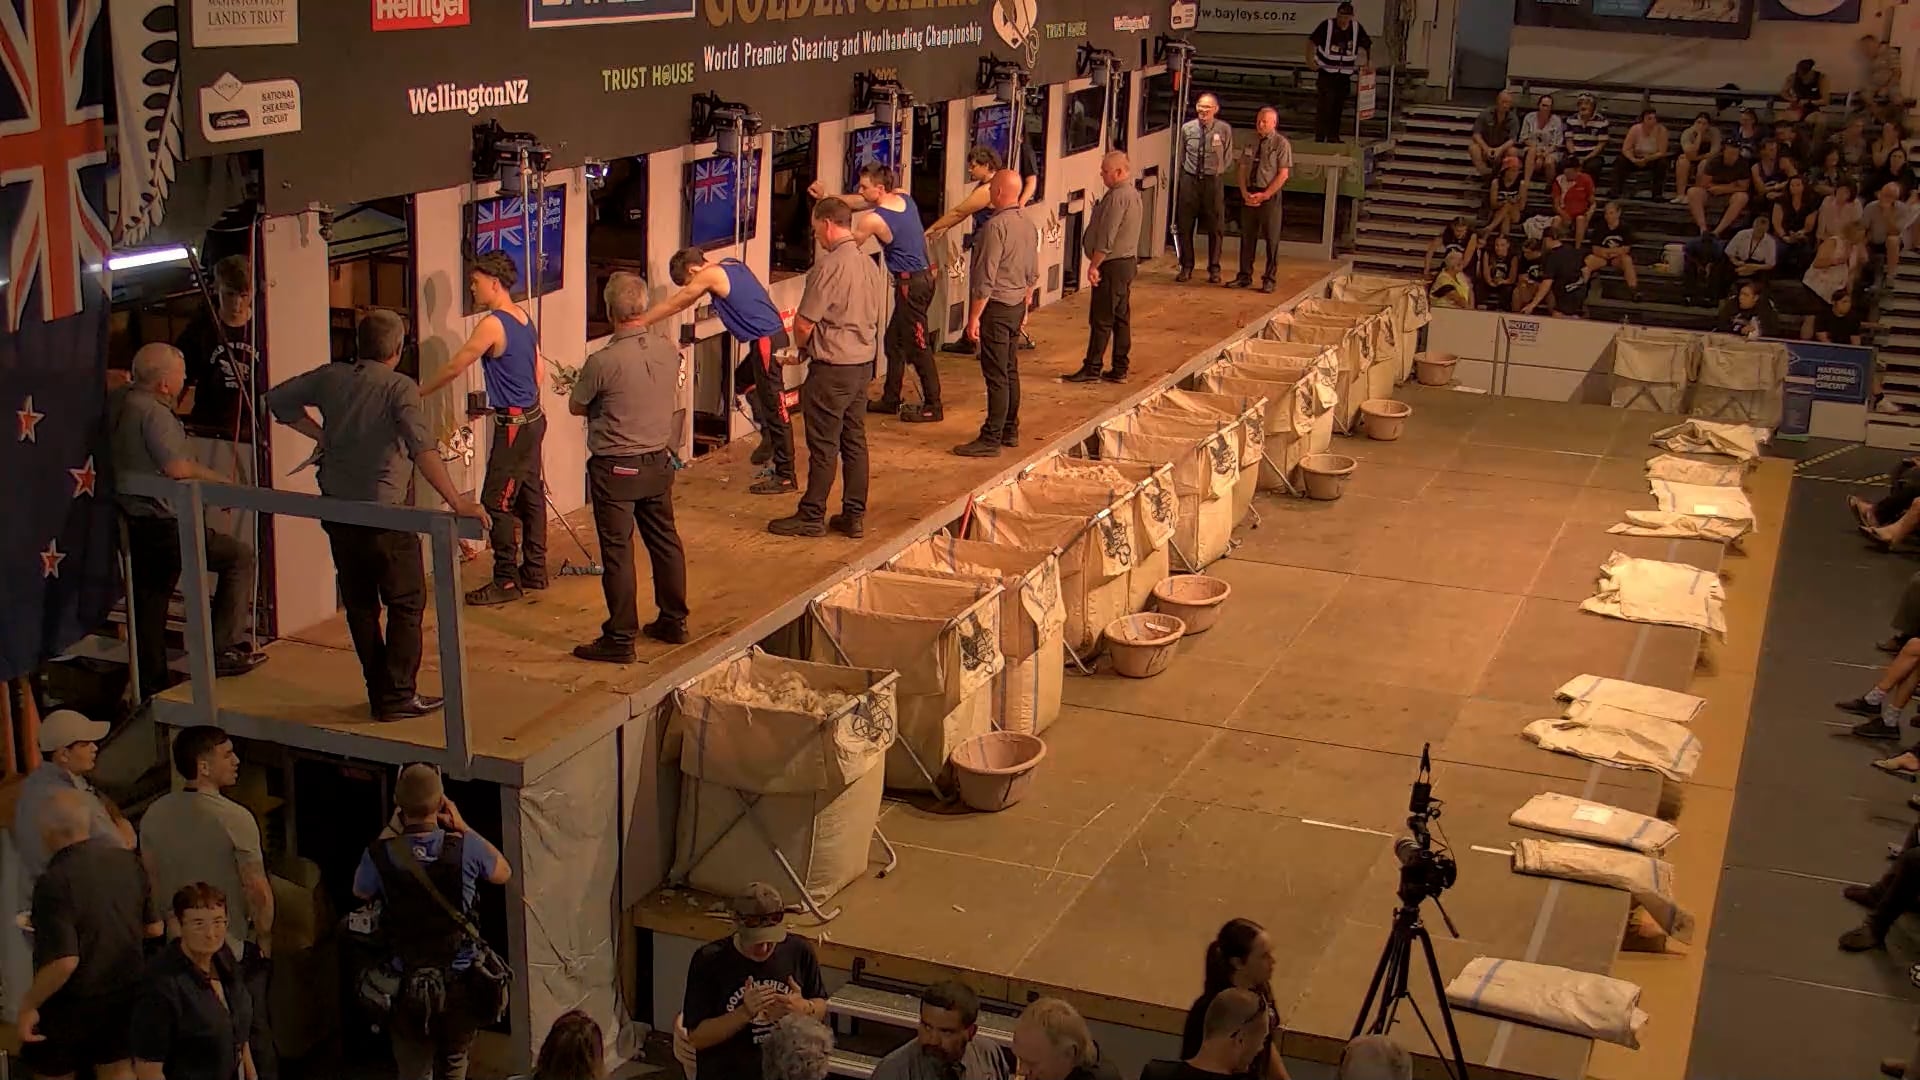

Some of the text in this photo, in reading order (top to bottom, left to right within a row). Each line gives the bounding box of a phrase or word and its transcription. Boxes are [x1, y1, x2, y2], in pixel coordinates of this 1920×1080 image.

[208, 9, 286, 26] LANDS TRUST
[1199, 8, 1297, 21] w.bayleys.co.nz
[703, 21, 982, 72] World Premier Shearing and Woolhandling Championship
[602, 62, 695, 92] TRUST HOUSE
[408, 79, 529, 115] WellingtonNZ
